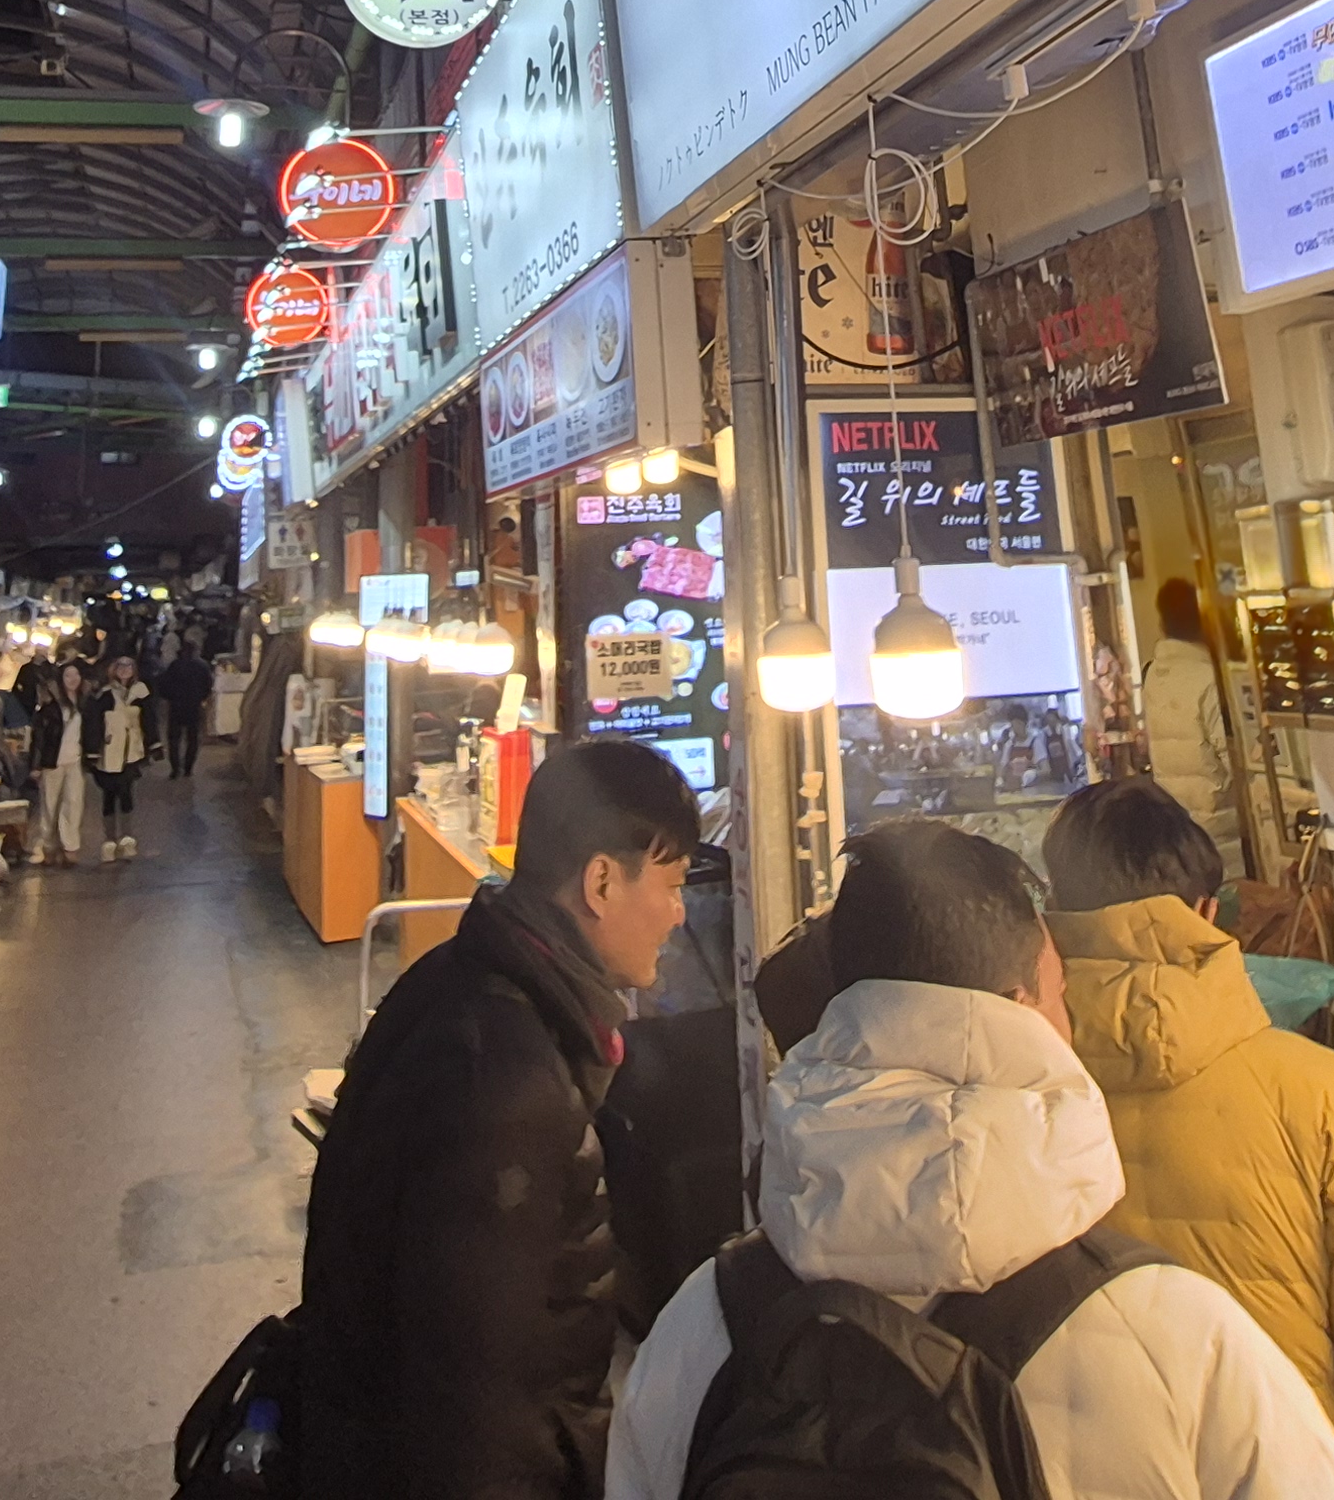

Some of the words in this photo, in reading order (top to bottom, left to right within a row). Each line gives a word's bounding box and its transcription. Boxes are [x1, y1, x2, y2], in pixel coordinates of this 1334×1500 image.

[399, 6, 460, 29] (본점)
[766, 33, 811, 96] MUNG
[501, 221, 581, 315] T.2263-0366
[1038, 294, 1131, 369] NETFLIX
[804, 352, 834, 374] ite
[831, 420, 940, 454] NETFLIX
[836, 462, 886, 474] NETFLIX
[605, 492, 682, 516] 진주육회
[838, 477, 869, 527] 길
[880, 478, 943, 516] 위의
[966, 536, 1009, 551] 대한국
[969, 609, 1021, 626] SEOUL
[599, 659, 662, 678] 12,000원
